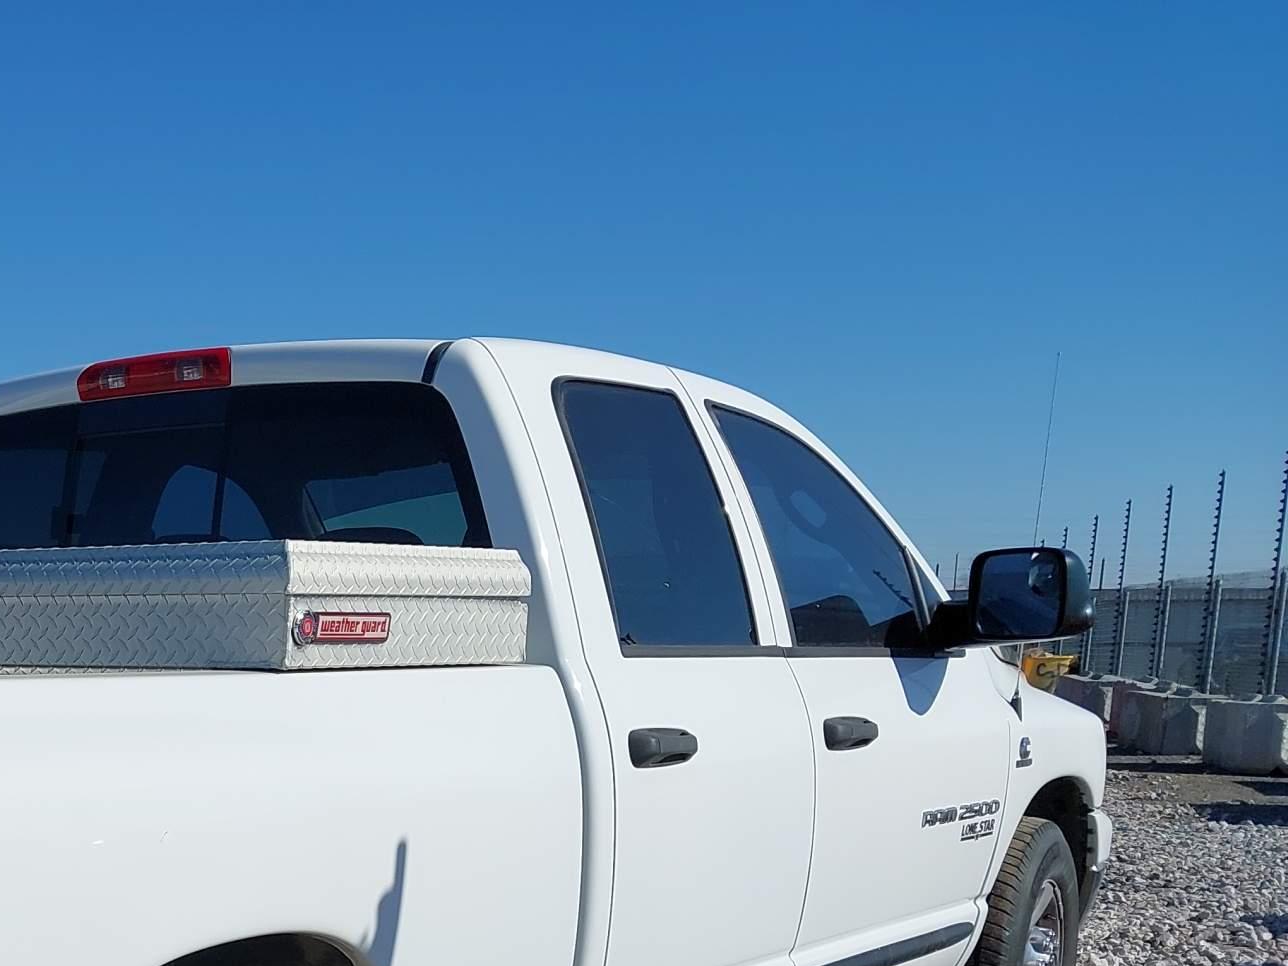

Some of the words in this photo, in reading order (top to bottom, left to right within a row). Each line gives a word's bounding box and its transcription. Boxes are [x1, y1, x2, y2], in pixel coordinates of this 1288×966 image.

[320, 618, 360, 633] weather
[360, 618, 388, 636] guard
[920, 806, 958, 829] RAM
[958, 799, 1001, 821] 2500
[979, 819, 996, 834] STAR
